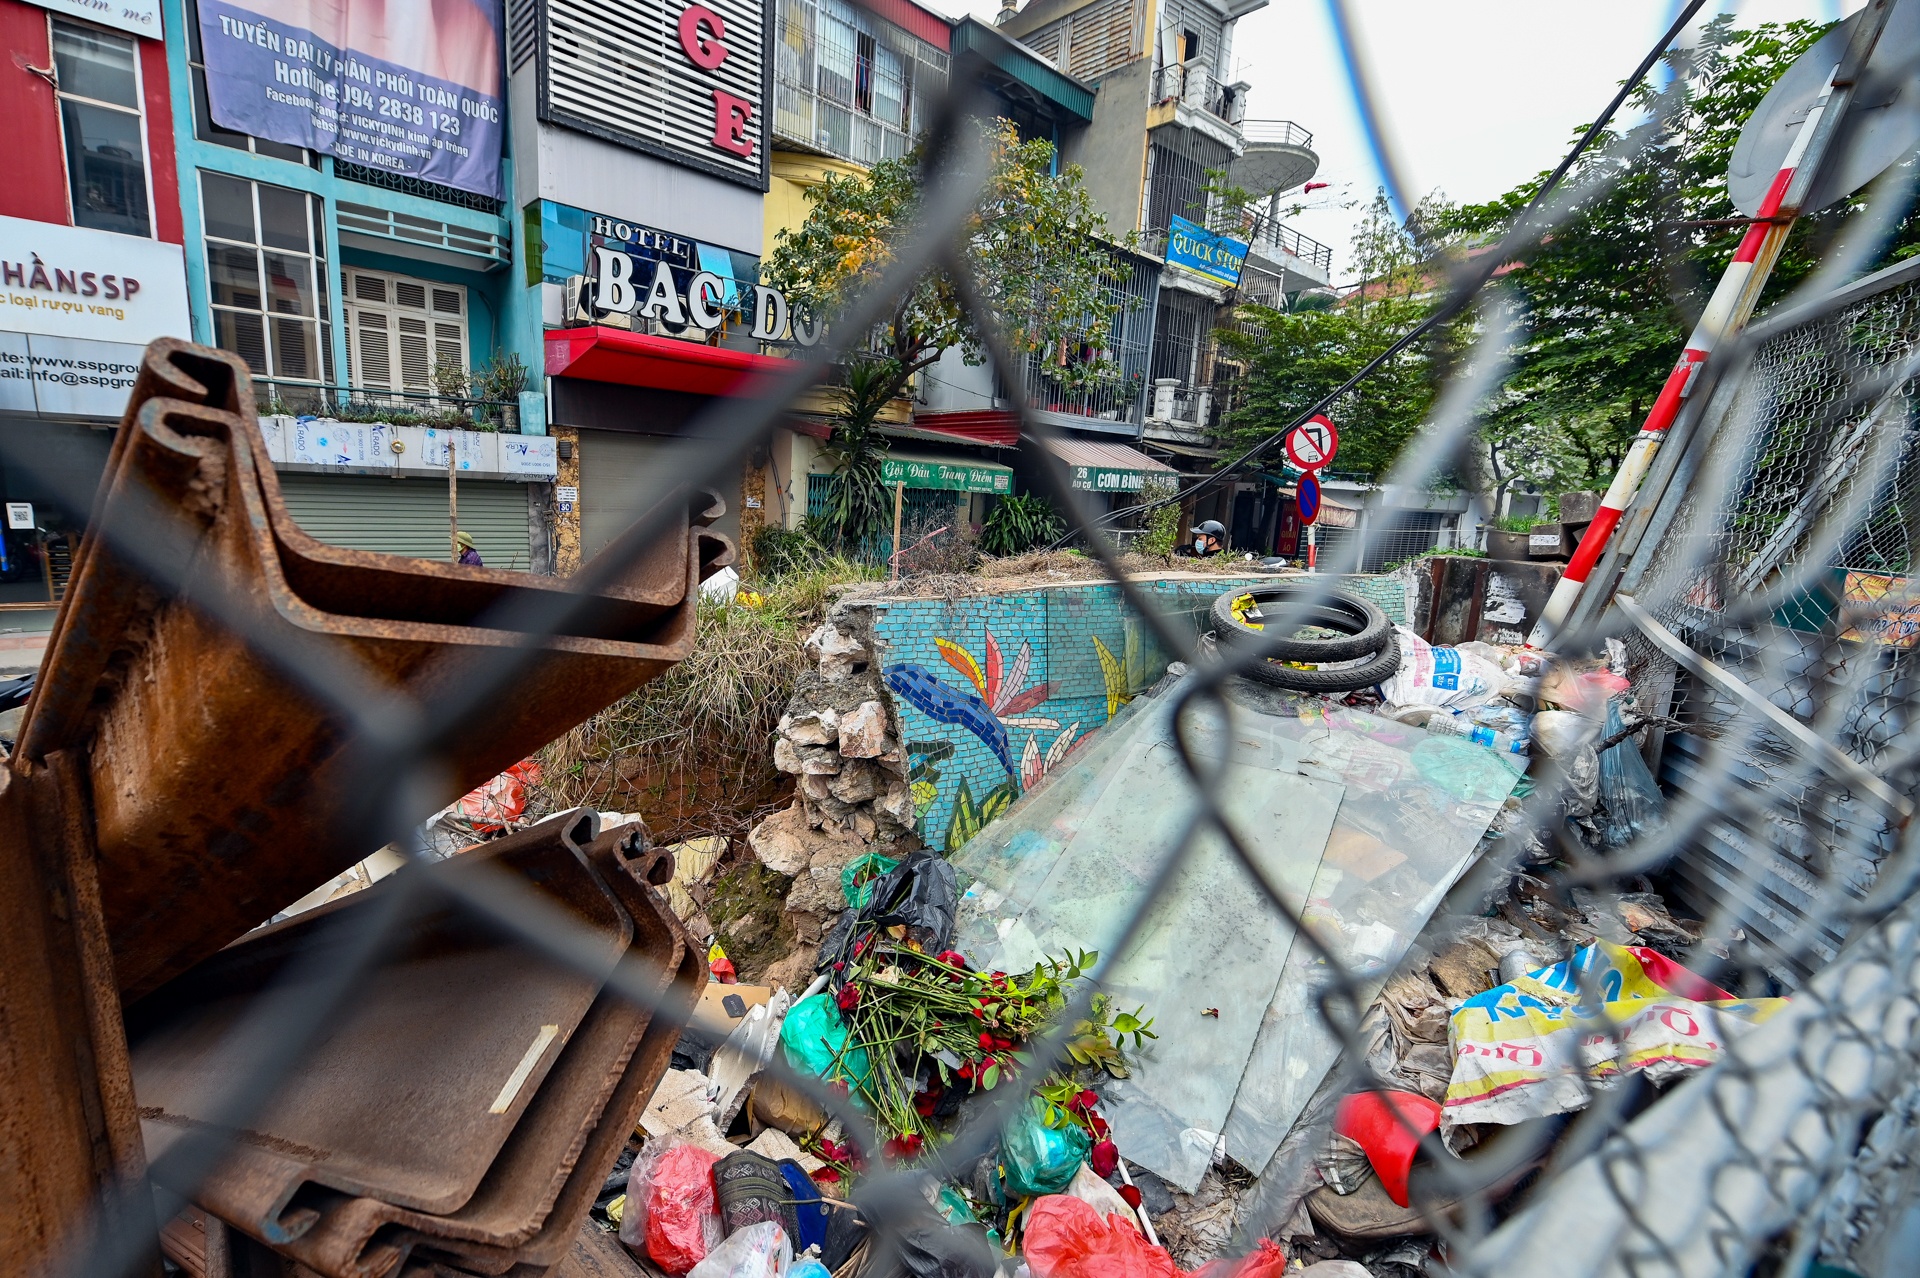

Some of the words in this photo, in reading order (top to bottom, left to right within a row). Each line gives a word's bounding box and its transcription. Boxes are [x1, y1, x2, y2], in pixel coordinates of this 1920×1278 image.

[122, 8, 152, 25] mê
[218, 14, 281, 53] TUYỂN
[284, 37, 314, 64] ĐẠI
[316, 48, 332, 72] LÝ
[375, 69, 413, 98] PHỐI
[417, 83, 458, 111] TOÀN
[461, 97, 499, 124] QUỐC
[274, 59, 341, 104] Hotline:
[379, 95, 424, 126] 2838
[429, 110, 461, 136] 123
[351, 113, 406, 139] VICKYDINH
[341, 127, 432, 160] www.vickydinh.vn
[357, 148, 370, 163] IN
[371, 151, 406, 171] KOREA
[591, 216, 690, 259] HOTEL
[1173, 232, 1215, 264] QUICK
[593, 246, 726, 331] BAC
[9, 292, 39, 311] loại
[42, 299, 84, 315] rượu
[87, 304, 125, 321] vang
[938, 465, 966, 483] Trang
[1077, 467, 1088, 479] 26
[1097, 473, 1120, 488] CƠM
